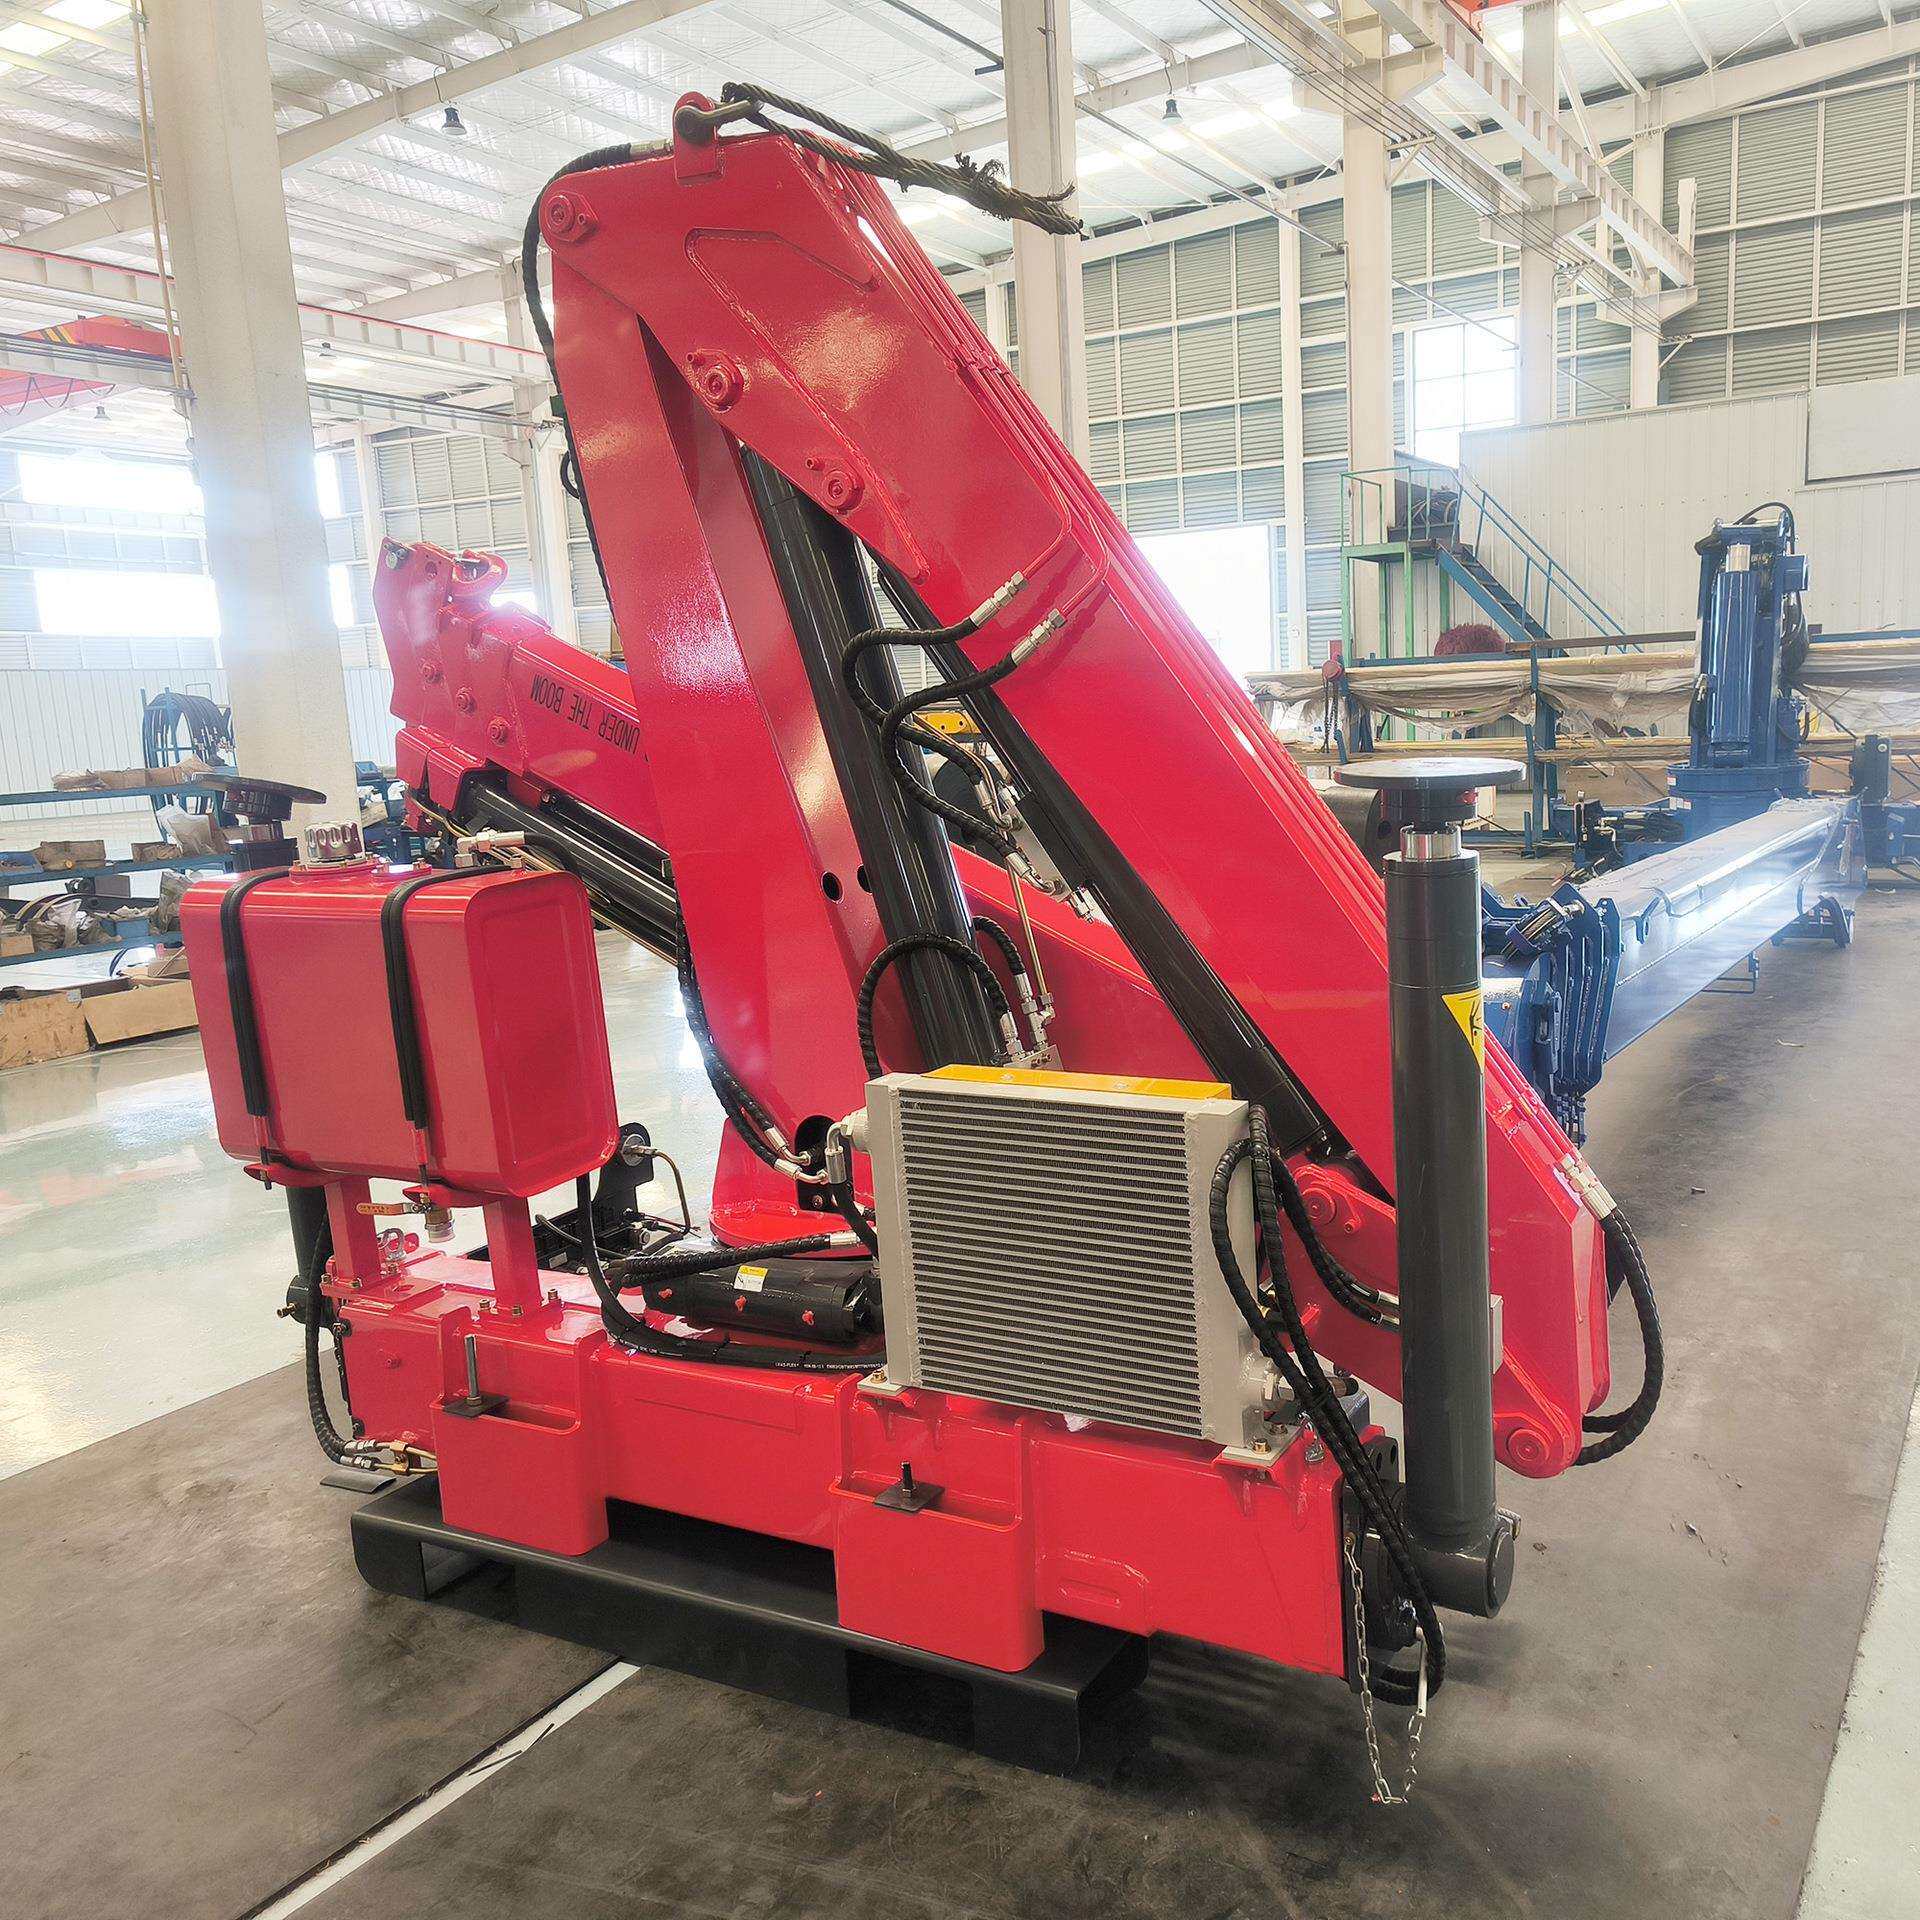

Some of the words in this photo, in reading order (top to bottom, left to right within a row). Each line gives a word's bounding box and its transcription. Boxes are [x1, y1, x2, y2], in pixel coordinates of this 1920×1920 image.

[530, 673, 564, 714] BOOM
[567, 693, 592, 730] THE
[599, 710, 640, 755] UNDER
